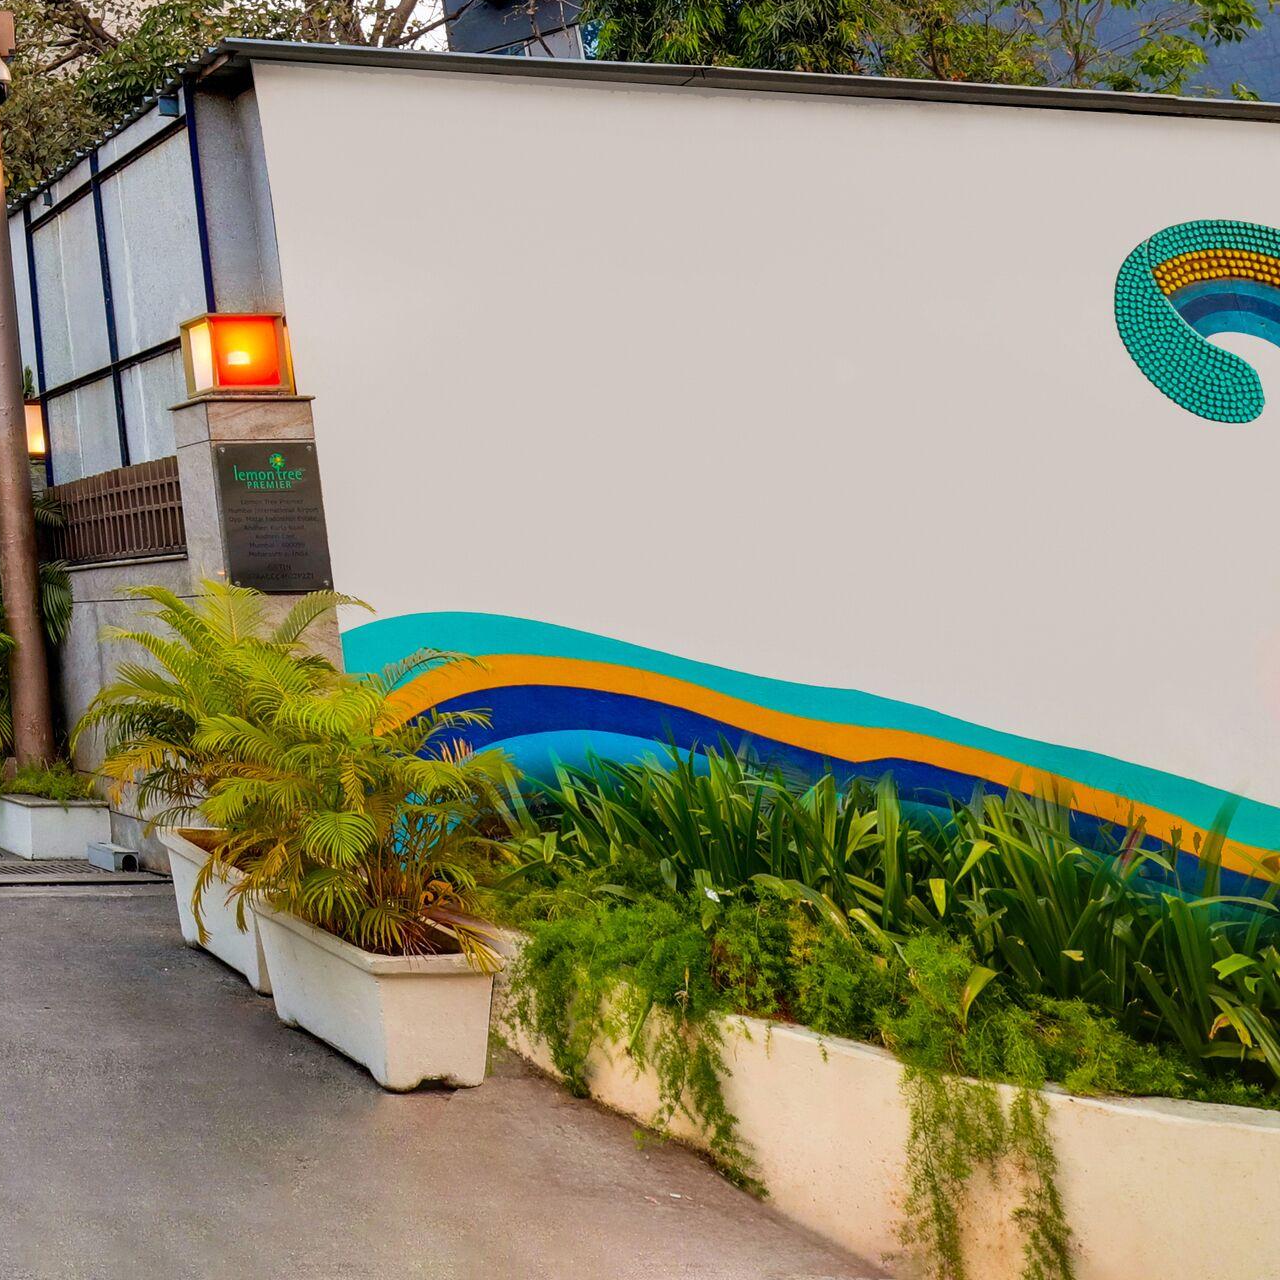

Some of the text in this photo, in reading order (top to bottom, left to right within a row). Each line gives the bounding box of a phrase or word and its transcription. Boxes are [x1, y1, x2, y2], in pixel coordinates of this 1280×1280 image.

[233, 464, 303, 481] lemon tree
[246, 480, 292, 489] PREMIER
